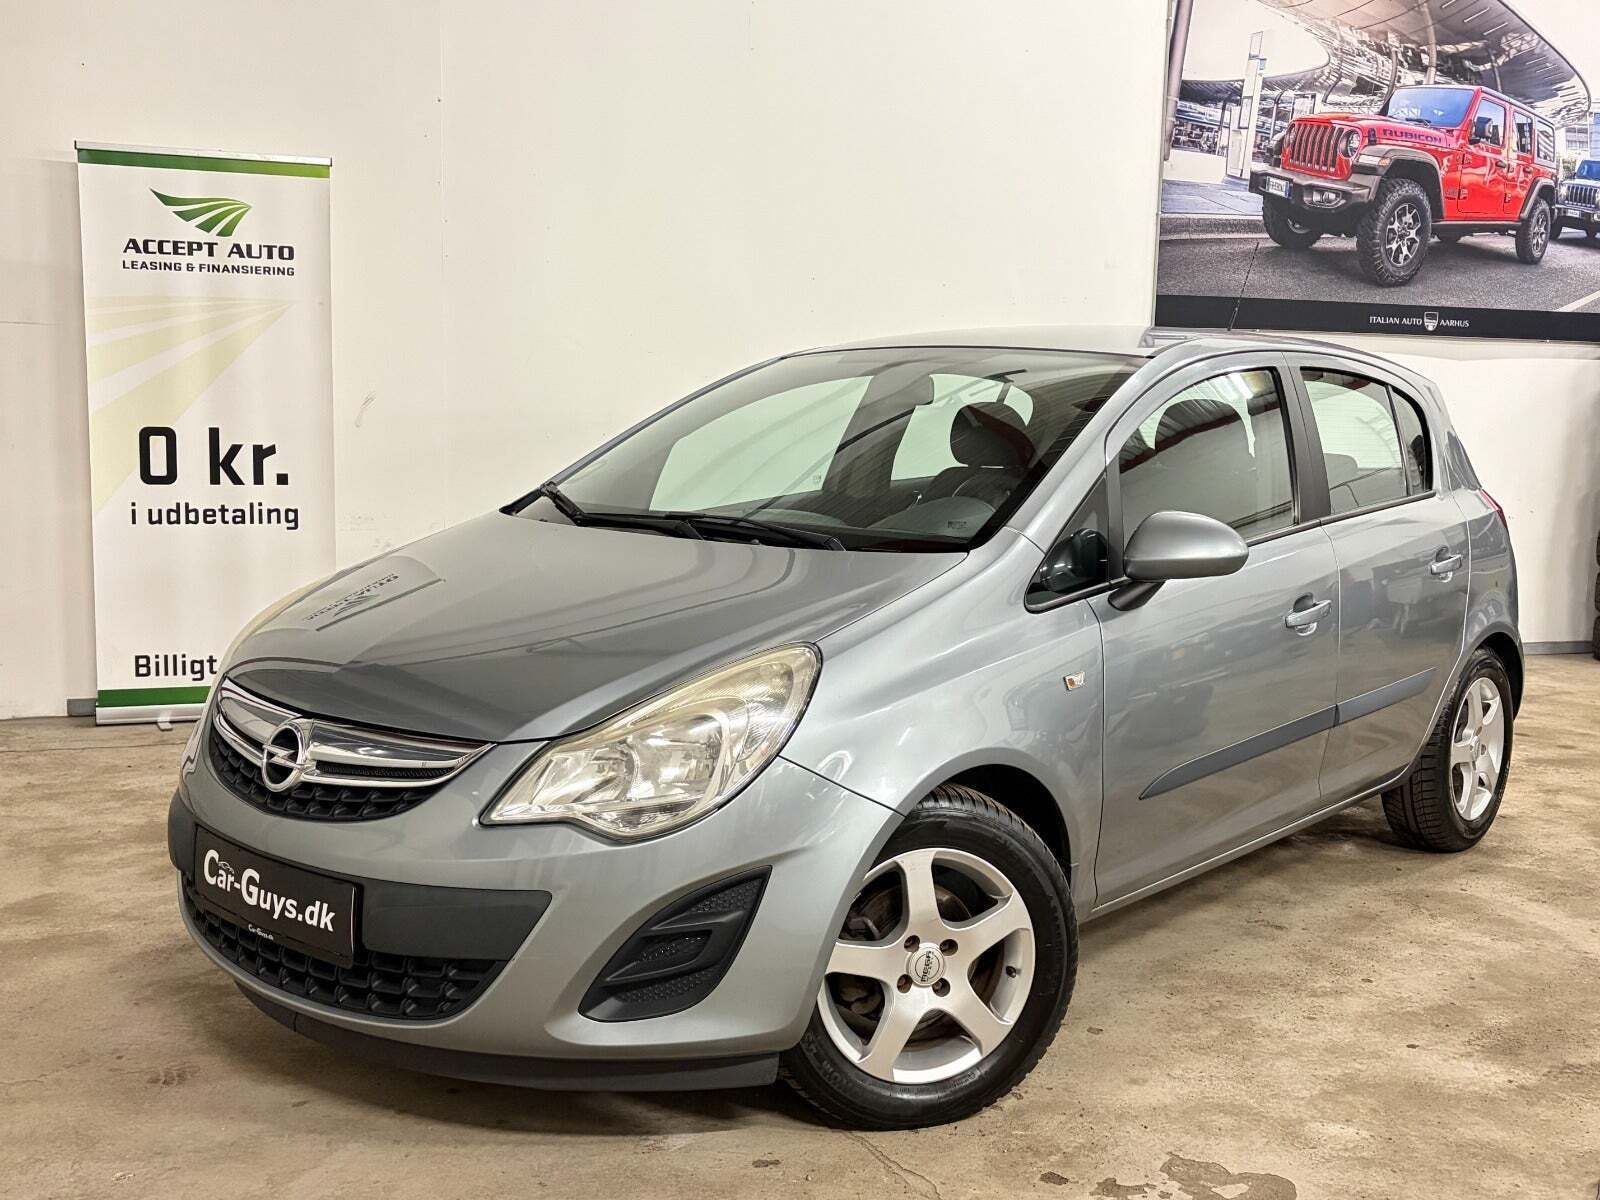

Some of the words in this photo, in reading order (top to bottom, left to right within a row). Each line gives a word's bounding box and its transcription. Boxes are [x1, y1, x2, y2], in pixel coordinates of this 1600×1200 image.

[1382, 128, 1442, 145] RUBICON
[123, 238, 218, 258] ACCEPT
[227, 243, 294, 261] AUTO
[122, 259, 182, 272] LEASING
[186, 262, 196, 272] &
[198, 263, 295, 277] FINANSIERING
[1369, 315, 1400, 324] ITALIAN
[1401, 317, 1423, 326] AUTO
[1439, 319, 1470, 328] AARHUS
[138, 426, 178, 486] 0
[208, 427, 289, 486] kr.
[131, 501, 137, 525] i
[147, 502, 299, 531] udbetaling
[134, 653, 218, 682] Billigt
[204, 849, 336, 931] Car-Guys.dk
